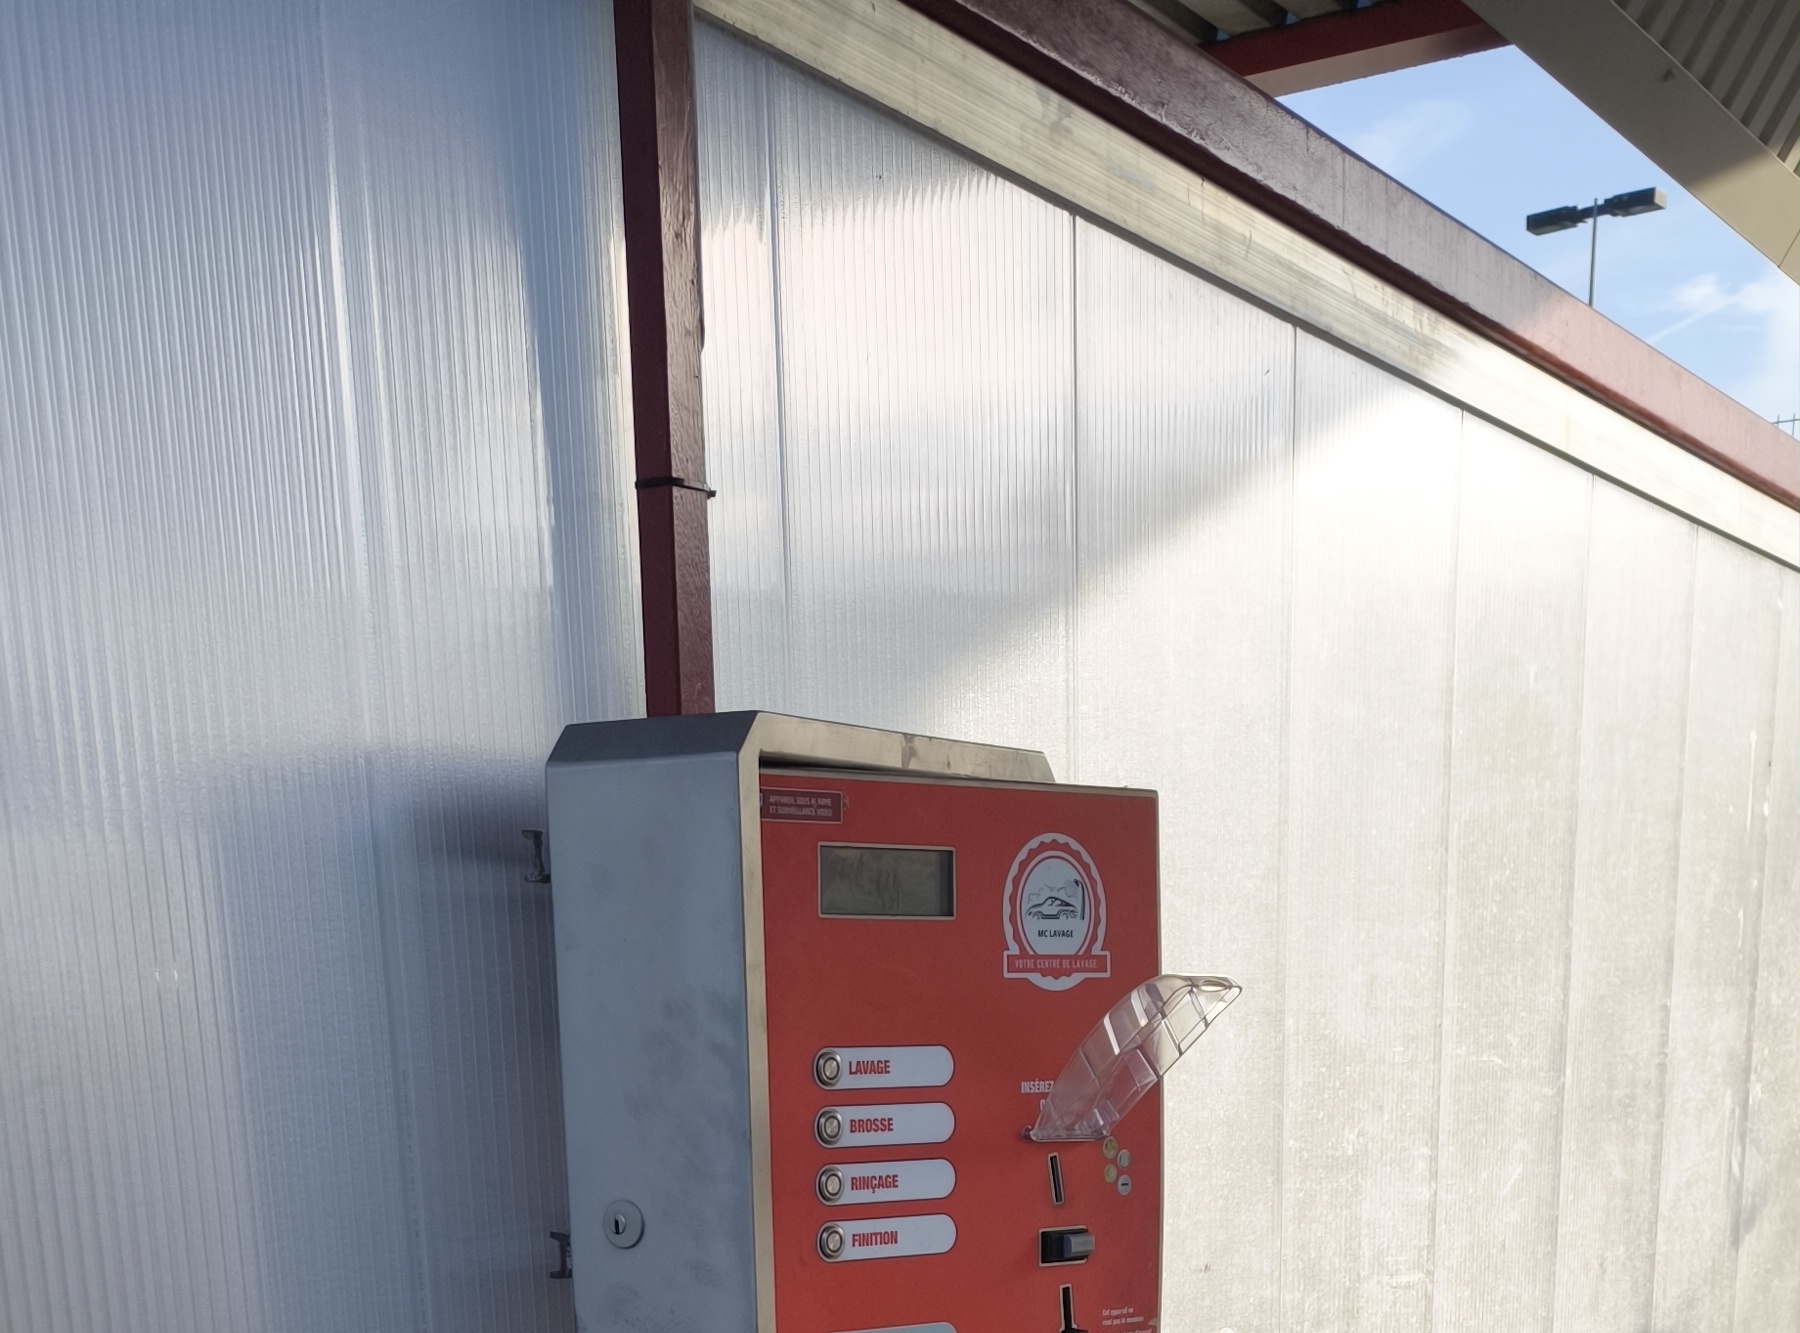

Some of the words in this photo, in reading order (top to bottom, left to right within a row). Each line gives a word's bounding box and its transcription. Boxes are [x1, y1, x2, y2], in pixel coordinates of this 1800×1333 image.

[1037, 929, 1048, 938] MC
[1049, 929, 1074, 938] LAVAGE
[1015, 959, 1034, 968] VOTRE
[1036, 959, 1060, 969] CENTRE
[1062, 959, 1070, 968] DE
[1072, 959, 1097, 968] LAVAGE
[848, 1060, 891, 1075] LAVAGE
[1021, 1078, 1055, 1093] INSÉREZ
[849, 1118, 894, 1133] BROSSE
[851, 1174, 899, 1194] RINÇAGE
[852, 1231, 898, 1247] FINITION
